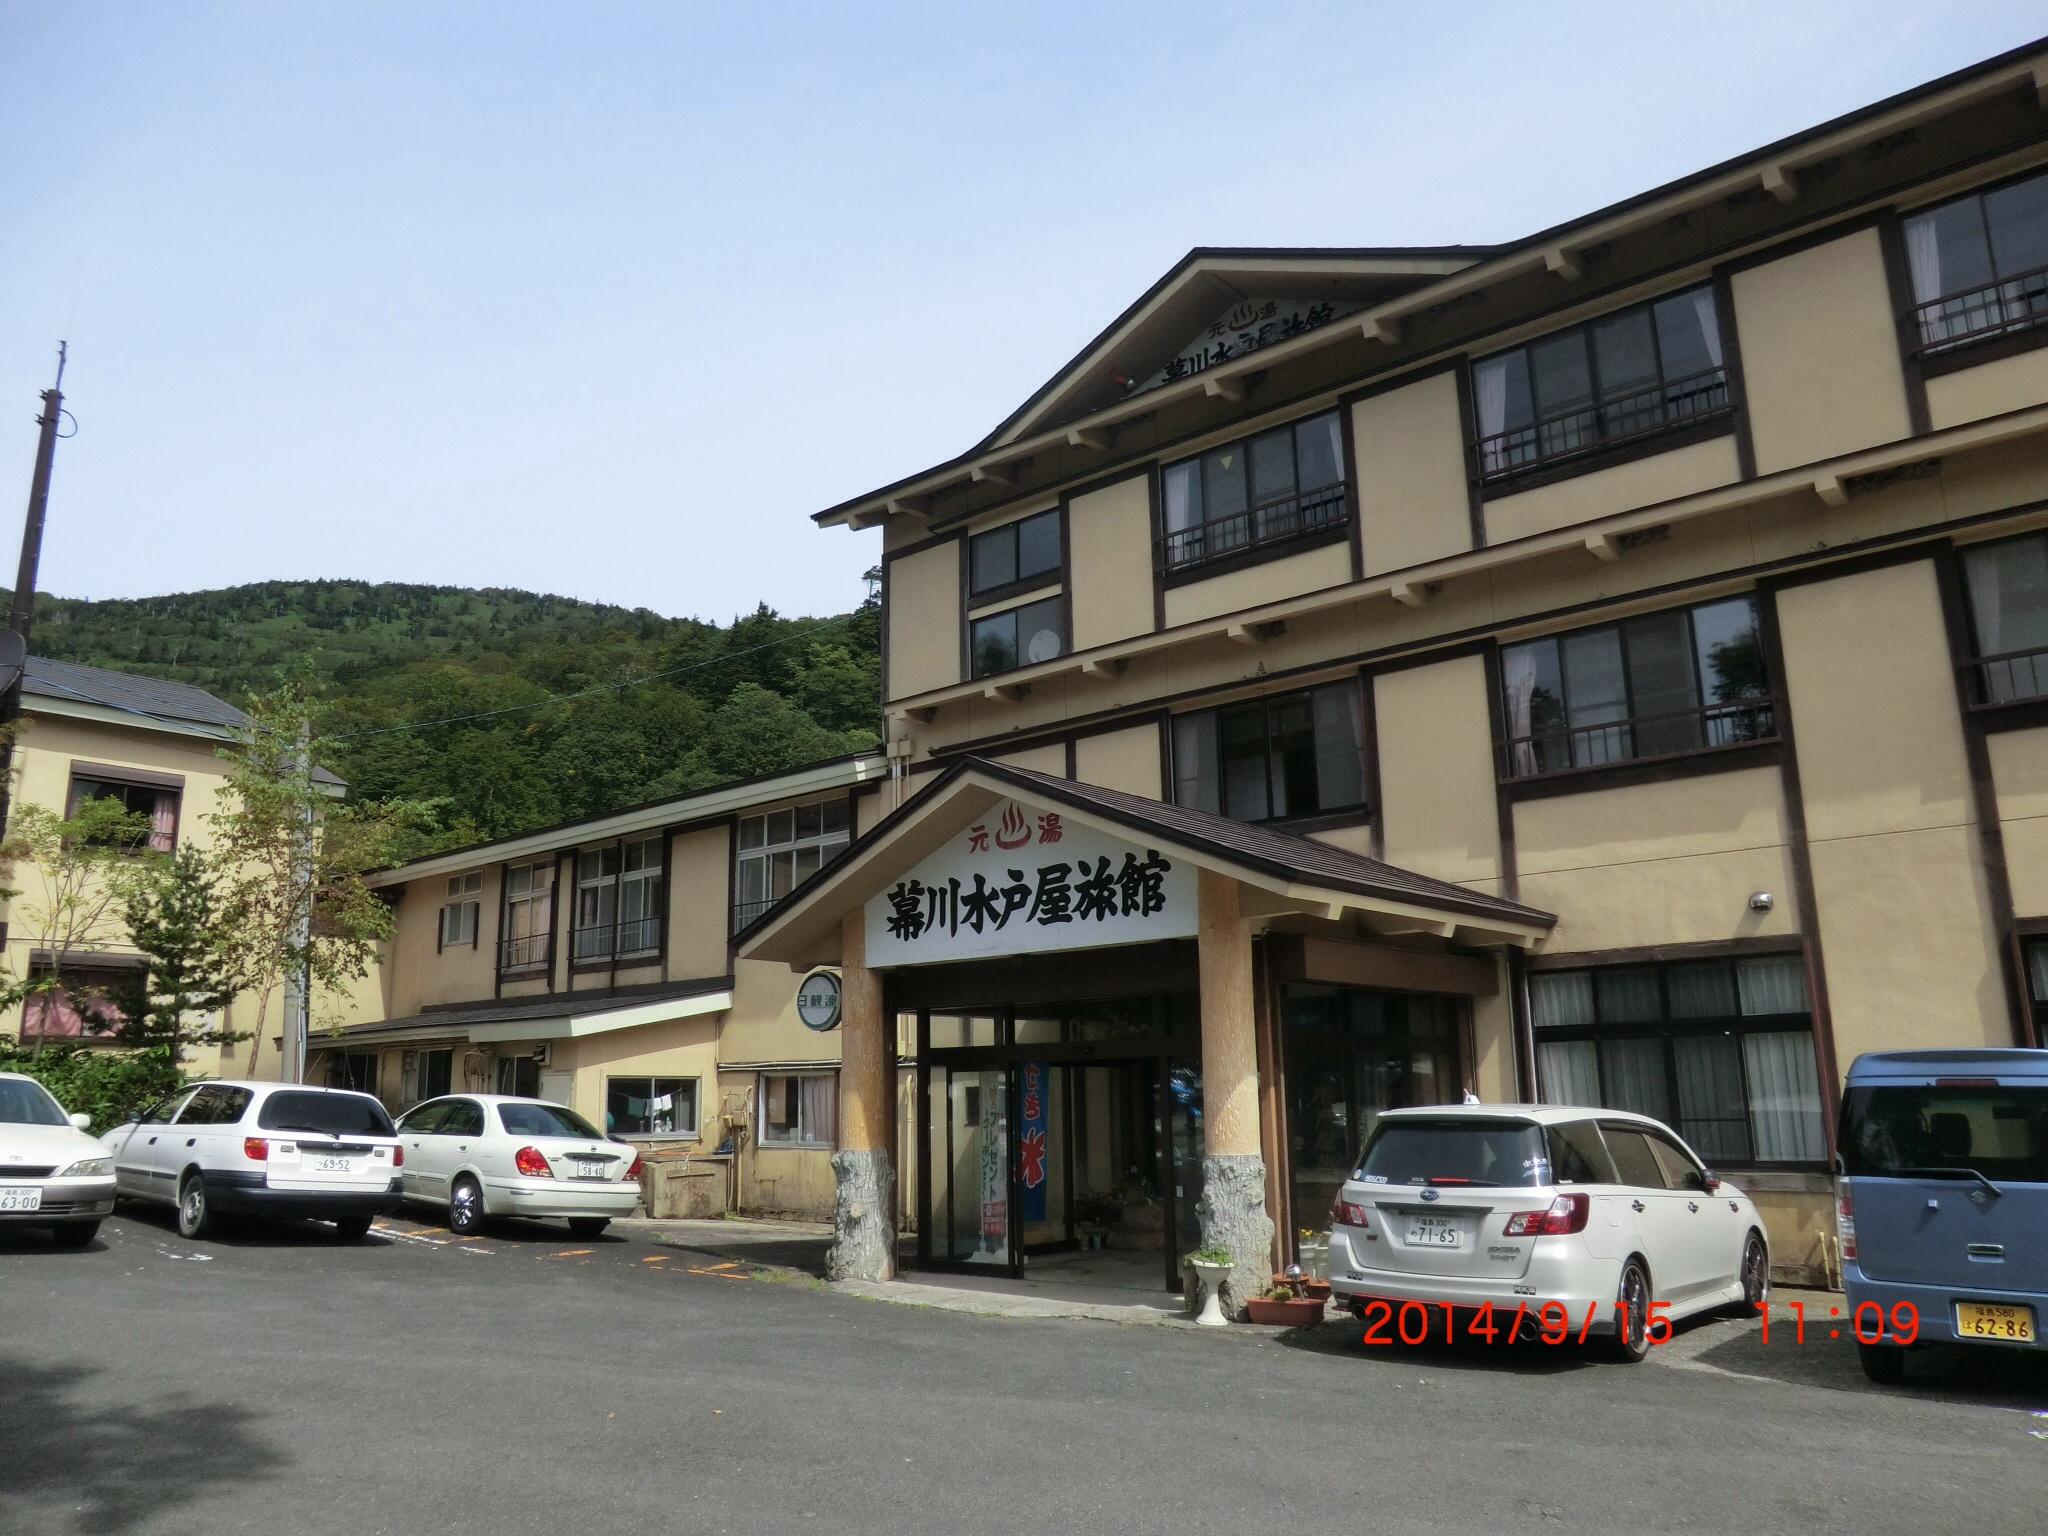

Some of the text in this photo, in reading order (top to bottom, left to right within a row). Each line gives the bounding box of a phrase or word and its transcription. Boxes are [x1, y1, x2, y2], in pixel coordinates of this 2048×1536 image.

[1208, 321, 1226, 340] 元
[968, 812, 1063, 854] 元 湯
[886, 849, 1172, 942] 幕川水戸屋旅館
[323, 1159, 350, 1170] 69-52
[583, 1166, 603, 1176] 58-40
[1, 1197, 38, 1209] 63-00
[1418, 1227, 1456, 1243] 71-65
[1975, 1318, 2029, 1338] 62-86
